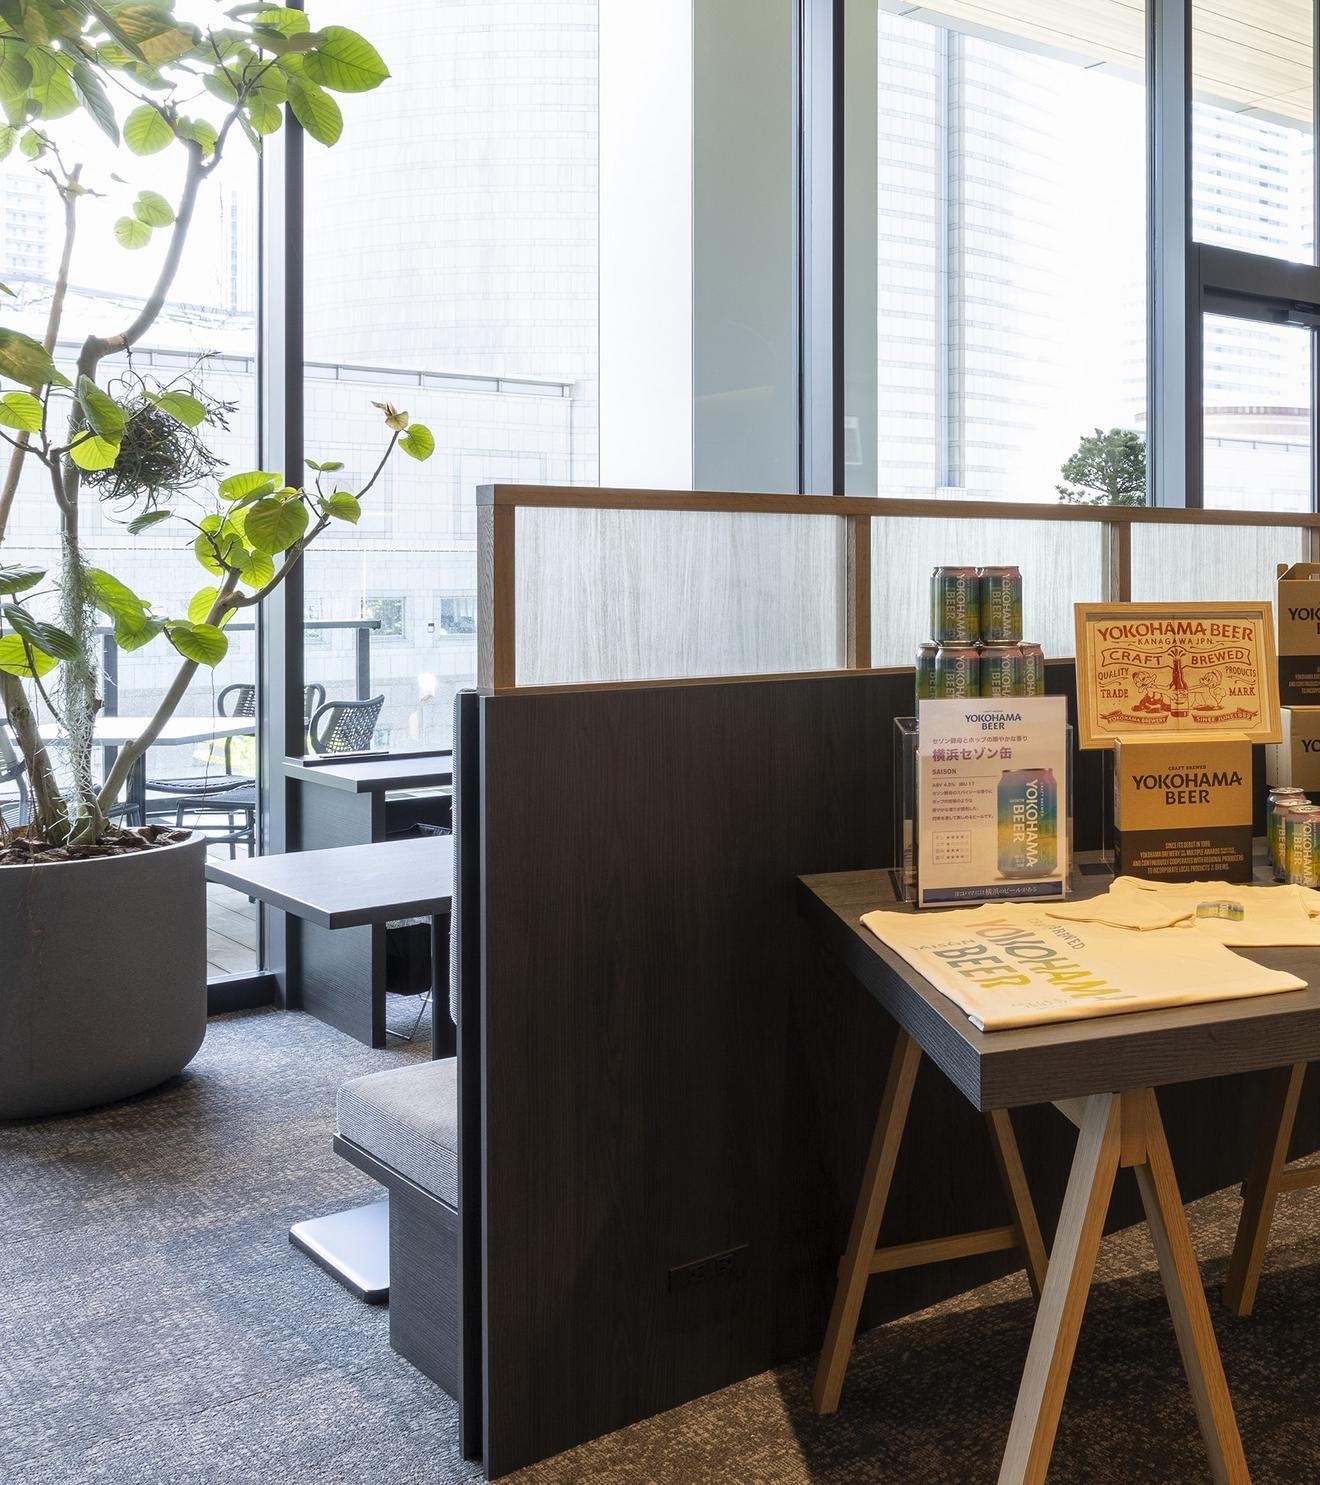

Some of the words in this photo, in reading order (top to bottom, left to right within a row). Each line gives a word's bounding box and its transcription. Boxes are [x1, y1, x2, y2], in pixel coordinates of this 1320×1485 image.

[945, 591, 956, 620] BEER
[955, 573, 966, 638] YOKOHAMA
[992, 591, 1001, 620] BEER
[1002, 573, 1013, 638] YOKOHAMA
[1097, 621, 1207, 642] YOKOHAMA
[1210, 623, 1253, 642] BEER
[1109, 651, 1163, 666] CRAFT
[1191, 650, 1244, 666] BREWED
[1097, 667, 1130, 681] QUALITY
[1225, 666, 1257, 678] PRODUCTS
[1100, 688, 1129, 699] TRADE
[1228, 687, 1256, 697] MARK
[965, 713, 1022, 722] YOKOHAMA
[981, 722, 1005, 731] BEER
[932, 746, 1013, 763] 横浜セゾン缶
[1132, 771, 1243, 790] YOKOHAMA
[1165, 789, 1210, 805] BEER
[1013, 804, 1025, 843] BEER
[1026, 779, 1039, 868] YOKOHAMA
[1278, 829, 1286, 857] BEER
[1293, 837, 1303, 865] BEER
[1303, 819, 1313, 885] YOKOHAMA
[933, 943, 1031, 989] BEER
